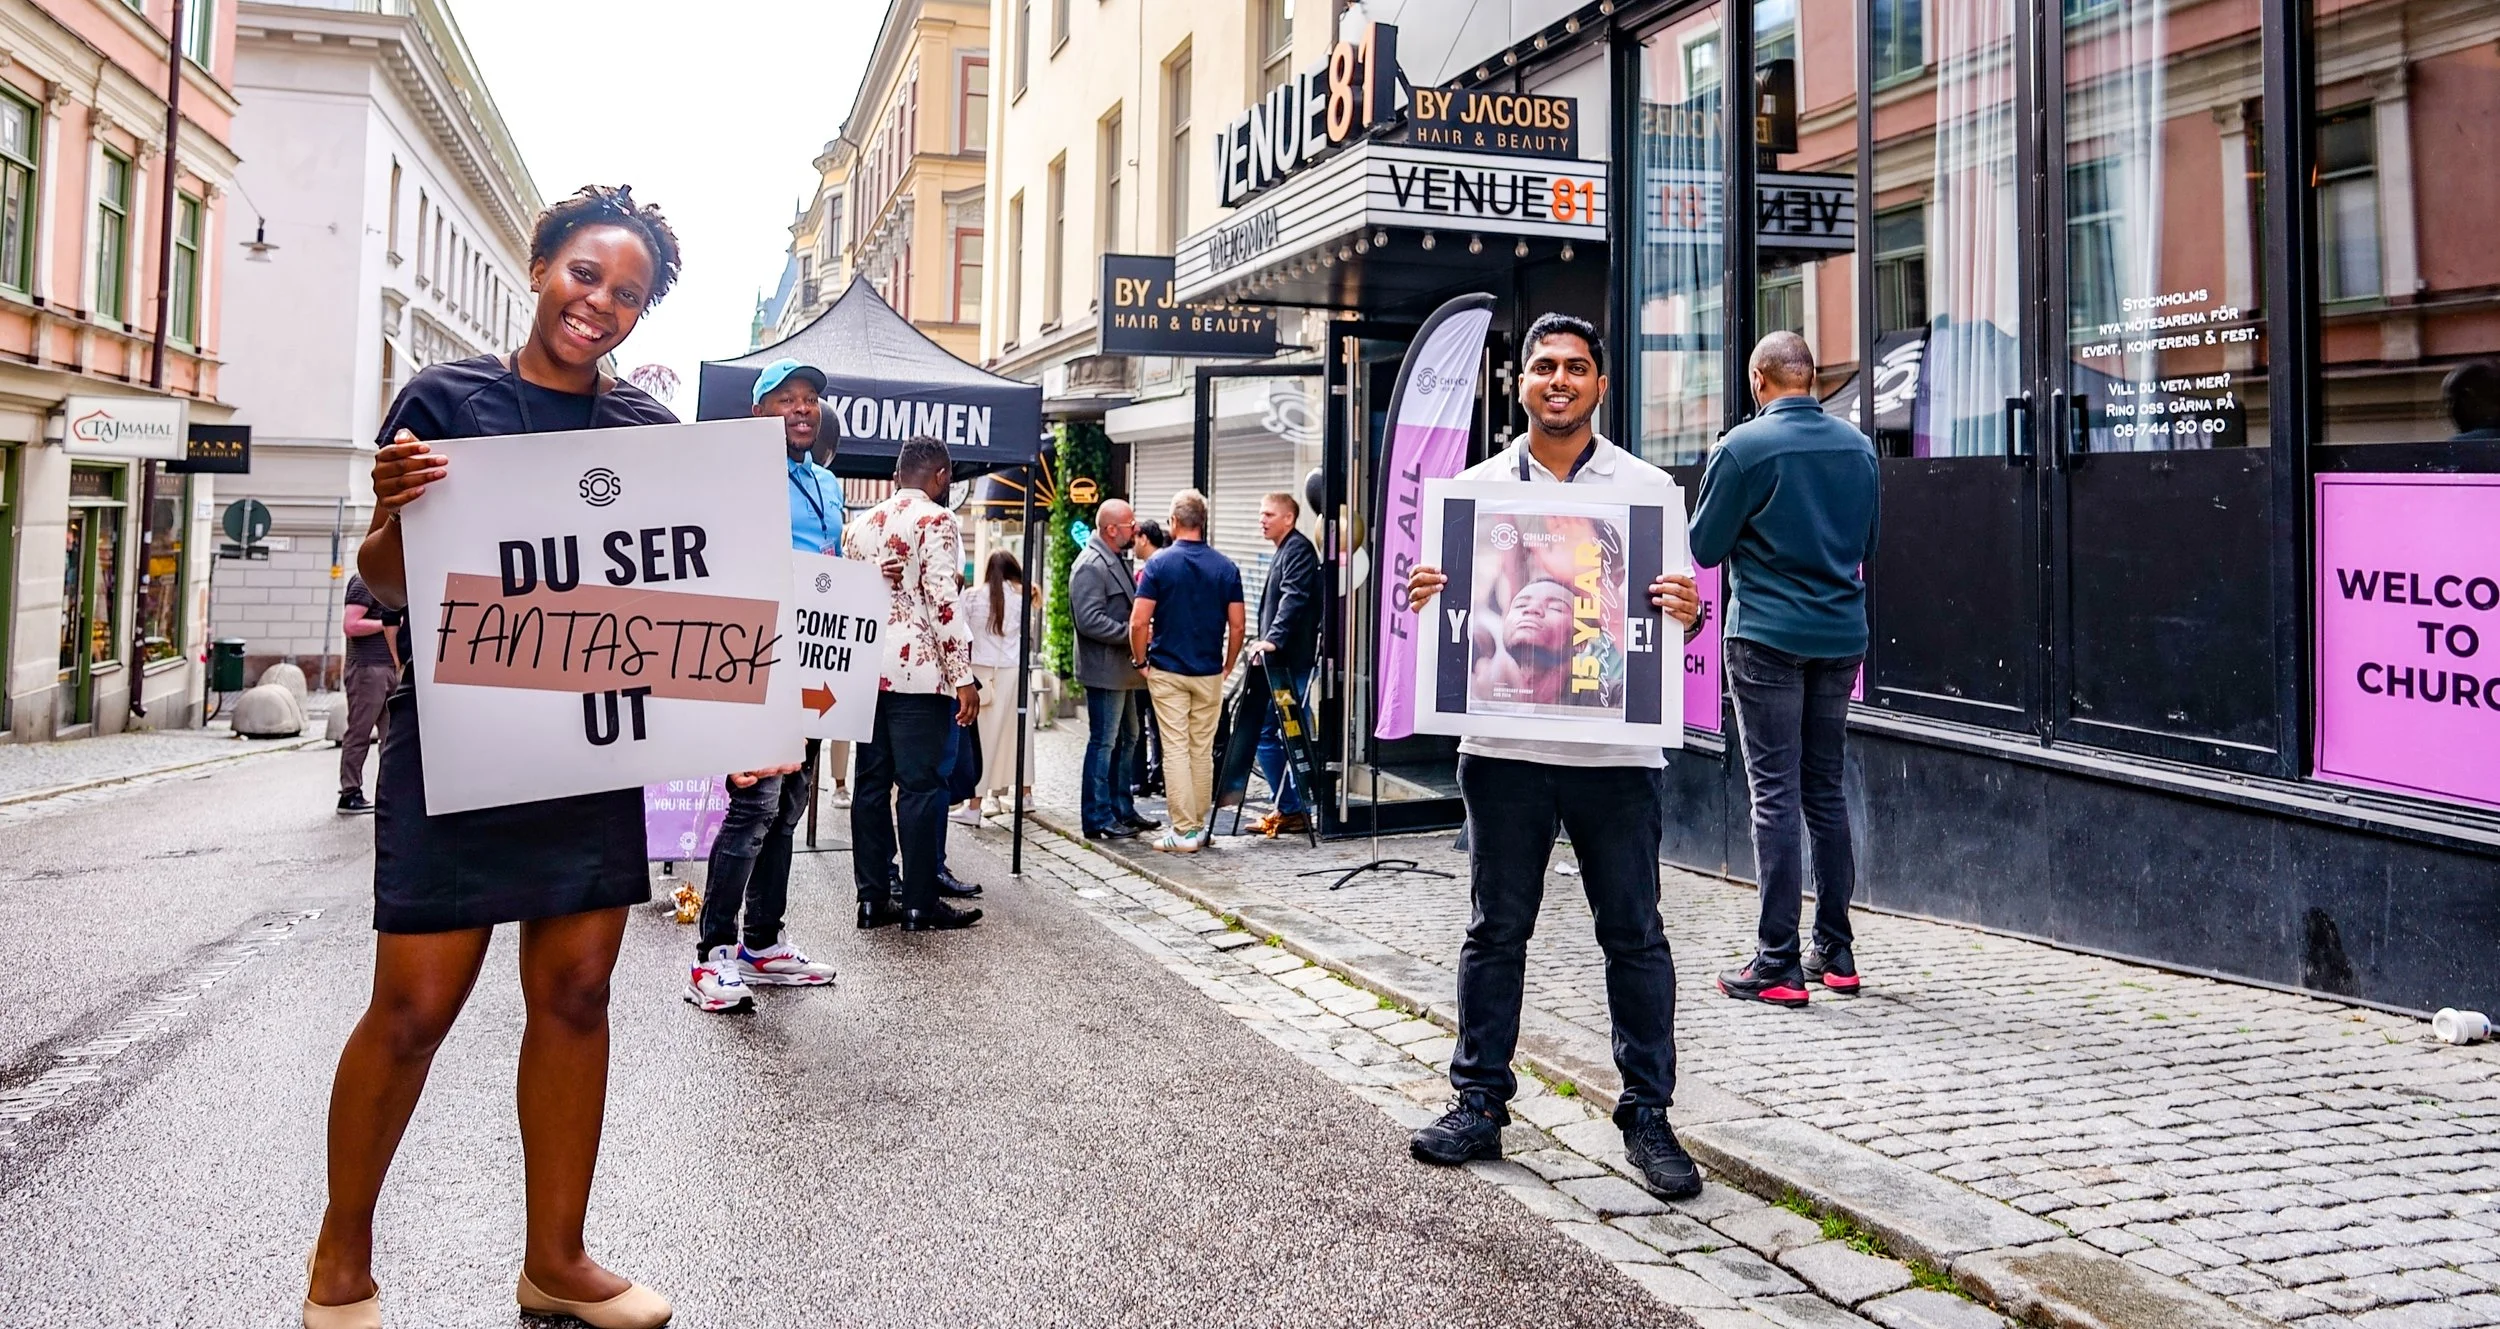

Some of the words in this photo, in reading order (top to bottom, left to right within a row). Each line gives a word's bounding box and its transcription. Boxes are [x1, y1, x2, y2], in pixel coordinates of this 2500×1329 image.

[1214, 21, 1378, 208] VENUE81
[1415, 90, 1454, 120] BY
[1460, 93, 1571, 130] JACOBS
[1417, 128, 1462, 145] HAIR
[1474, 131, 1486, 146] &
[1497, 132, 1570, 152] BEAUTY
[1388, 164, 1594, 225] VENUE81
[1115, 278, 1151, 307] BY
[1115, 313, 1159, 329] HAIR
[1170, 315, 1180, 331] &
[1192, 317, 1262, 334] BEAUTY
[2204, 330, 2217, 345] &
[827, 394, 992, 448] KOMMEN
[2113, 420, 2170, 438] 08-744
[2175, 419, 2198, 434] 30
[2202, 418, 2226, 433] 60
[579, 474, 621, 499] SOS
[1398, 462, 1421, 541] ALL
[1490, 529, 1519, 545] SOS
[1522, 532, 1566, 543] CHURCH
[499, 535, 580, 597] DU
[602, 525, 710, 586] SER
[1390, 553, 1413, 640] FOR
[1573, 543, 1601, 646] YEAR
[2336, 567, 2500, 611] WELCO
[437, 600, 783, 685] FANTASTISK
[796, 608, 849, 640] COME
[855, 617, 878, 643] TO
[1627, 617, 1654, 652] E!
[2417, 620, 2480, 658] TO
[1572, 656, 1600, 694] 15
[2356, 661, 2500, 712] CHURC
[582, 686, 652, 746] UT
[654, 797, 692, 811] YOU'RE
[694, 797, 724, 811] HRE!
[669, 779, 684, 793] SO
